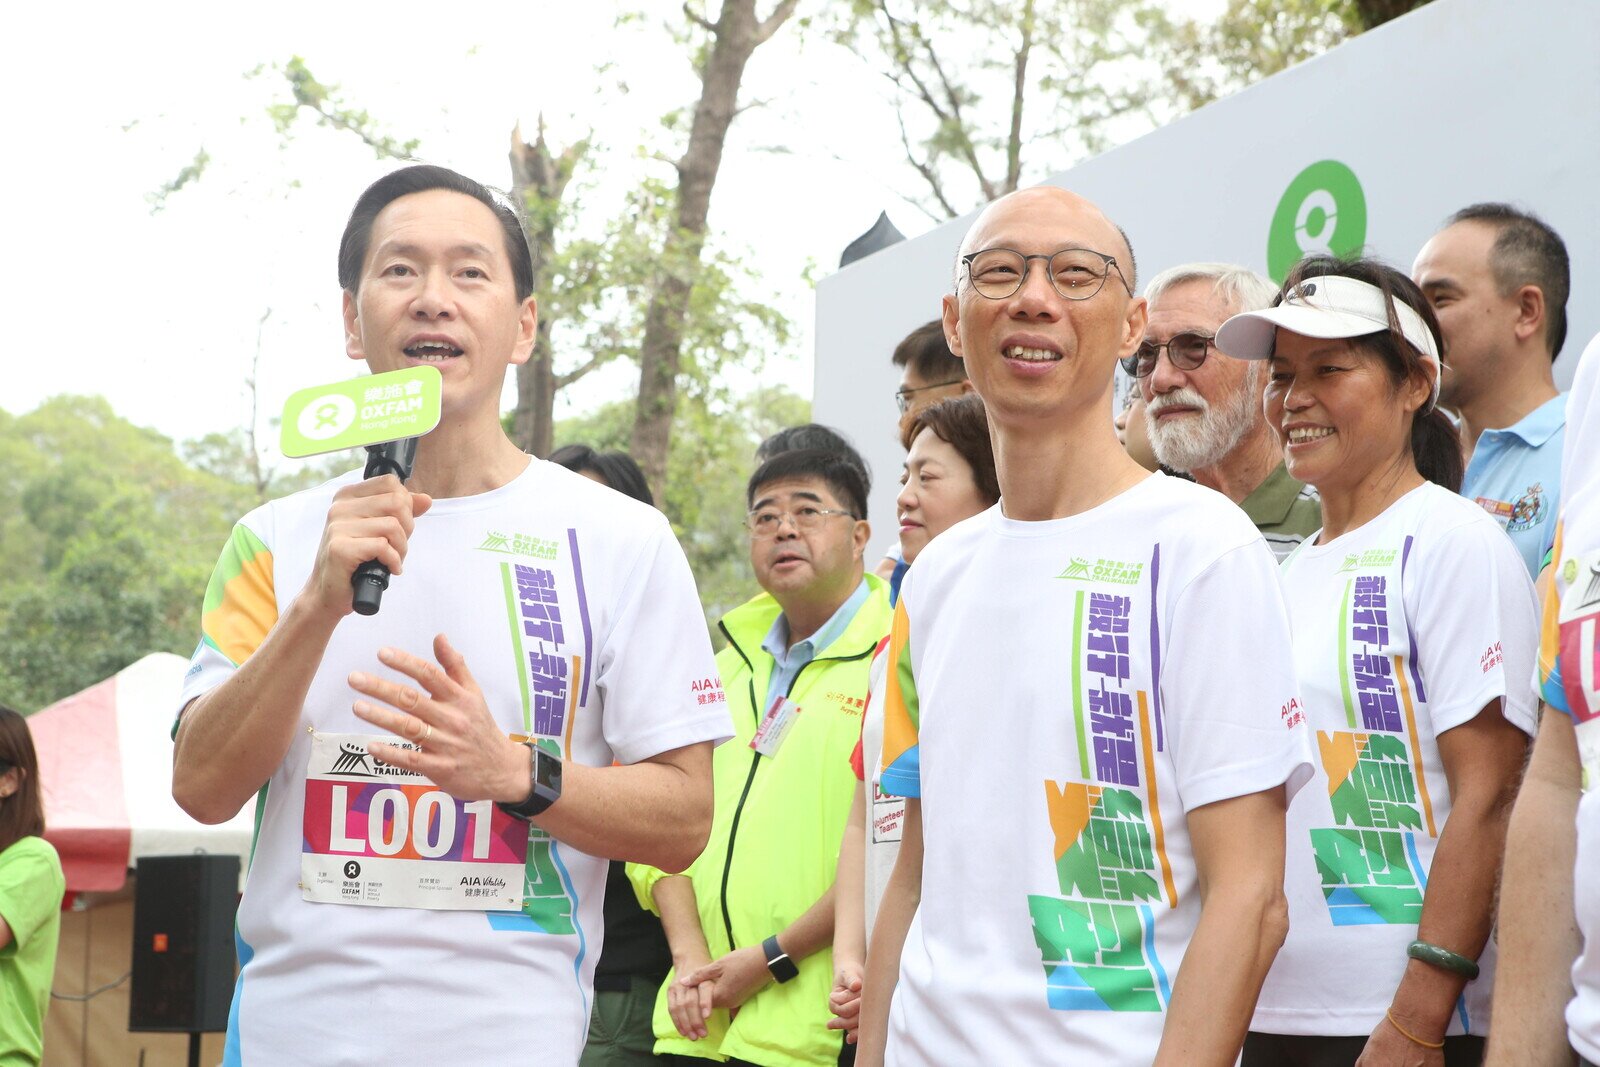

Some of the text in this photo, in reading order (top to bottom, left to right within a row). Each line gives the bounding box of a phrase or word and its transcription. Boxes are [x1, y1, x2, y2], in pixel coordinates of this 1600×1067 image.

[364, 379, 424, 402] 樂施會
[361, 397, 422, 420] OXFAM
[361, 413, 417, 430] Hong Kong
[512, 540, 557, 555] OXFAM
[1092, 575, 1138, 585] TRAILWALKER
[1094, 565, 1140, 579] OXFAM
[1480, 647, 1493, 667] AIA
[691, 679, 713, 692] AIA
[1281, 698, 1298, 719] AIA
[329, 785, 492, 859] L001
[875, 810, 904, 828] Volunteer
[880, 822, 897, 834] Team
[460, 876, 506, 889] AIA Vitality
[464, 888, 498, 898] 健康程式
